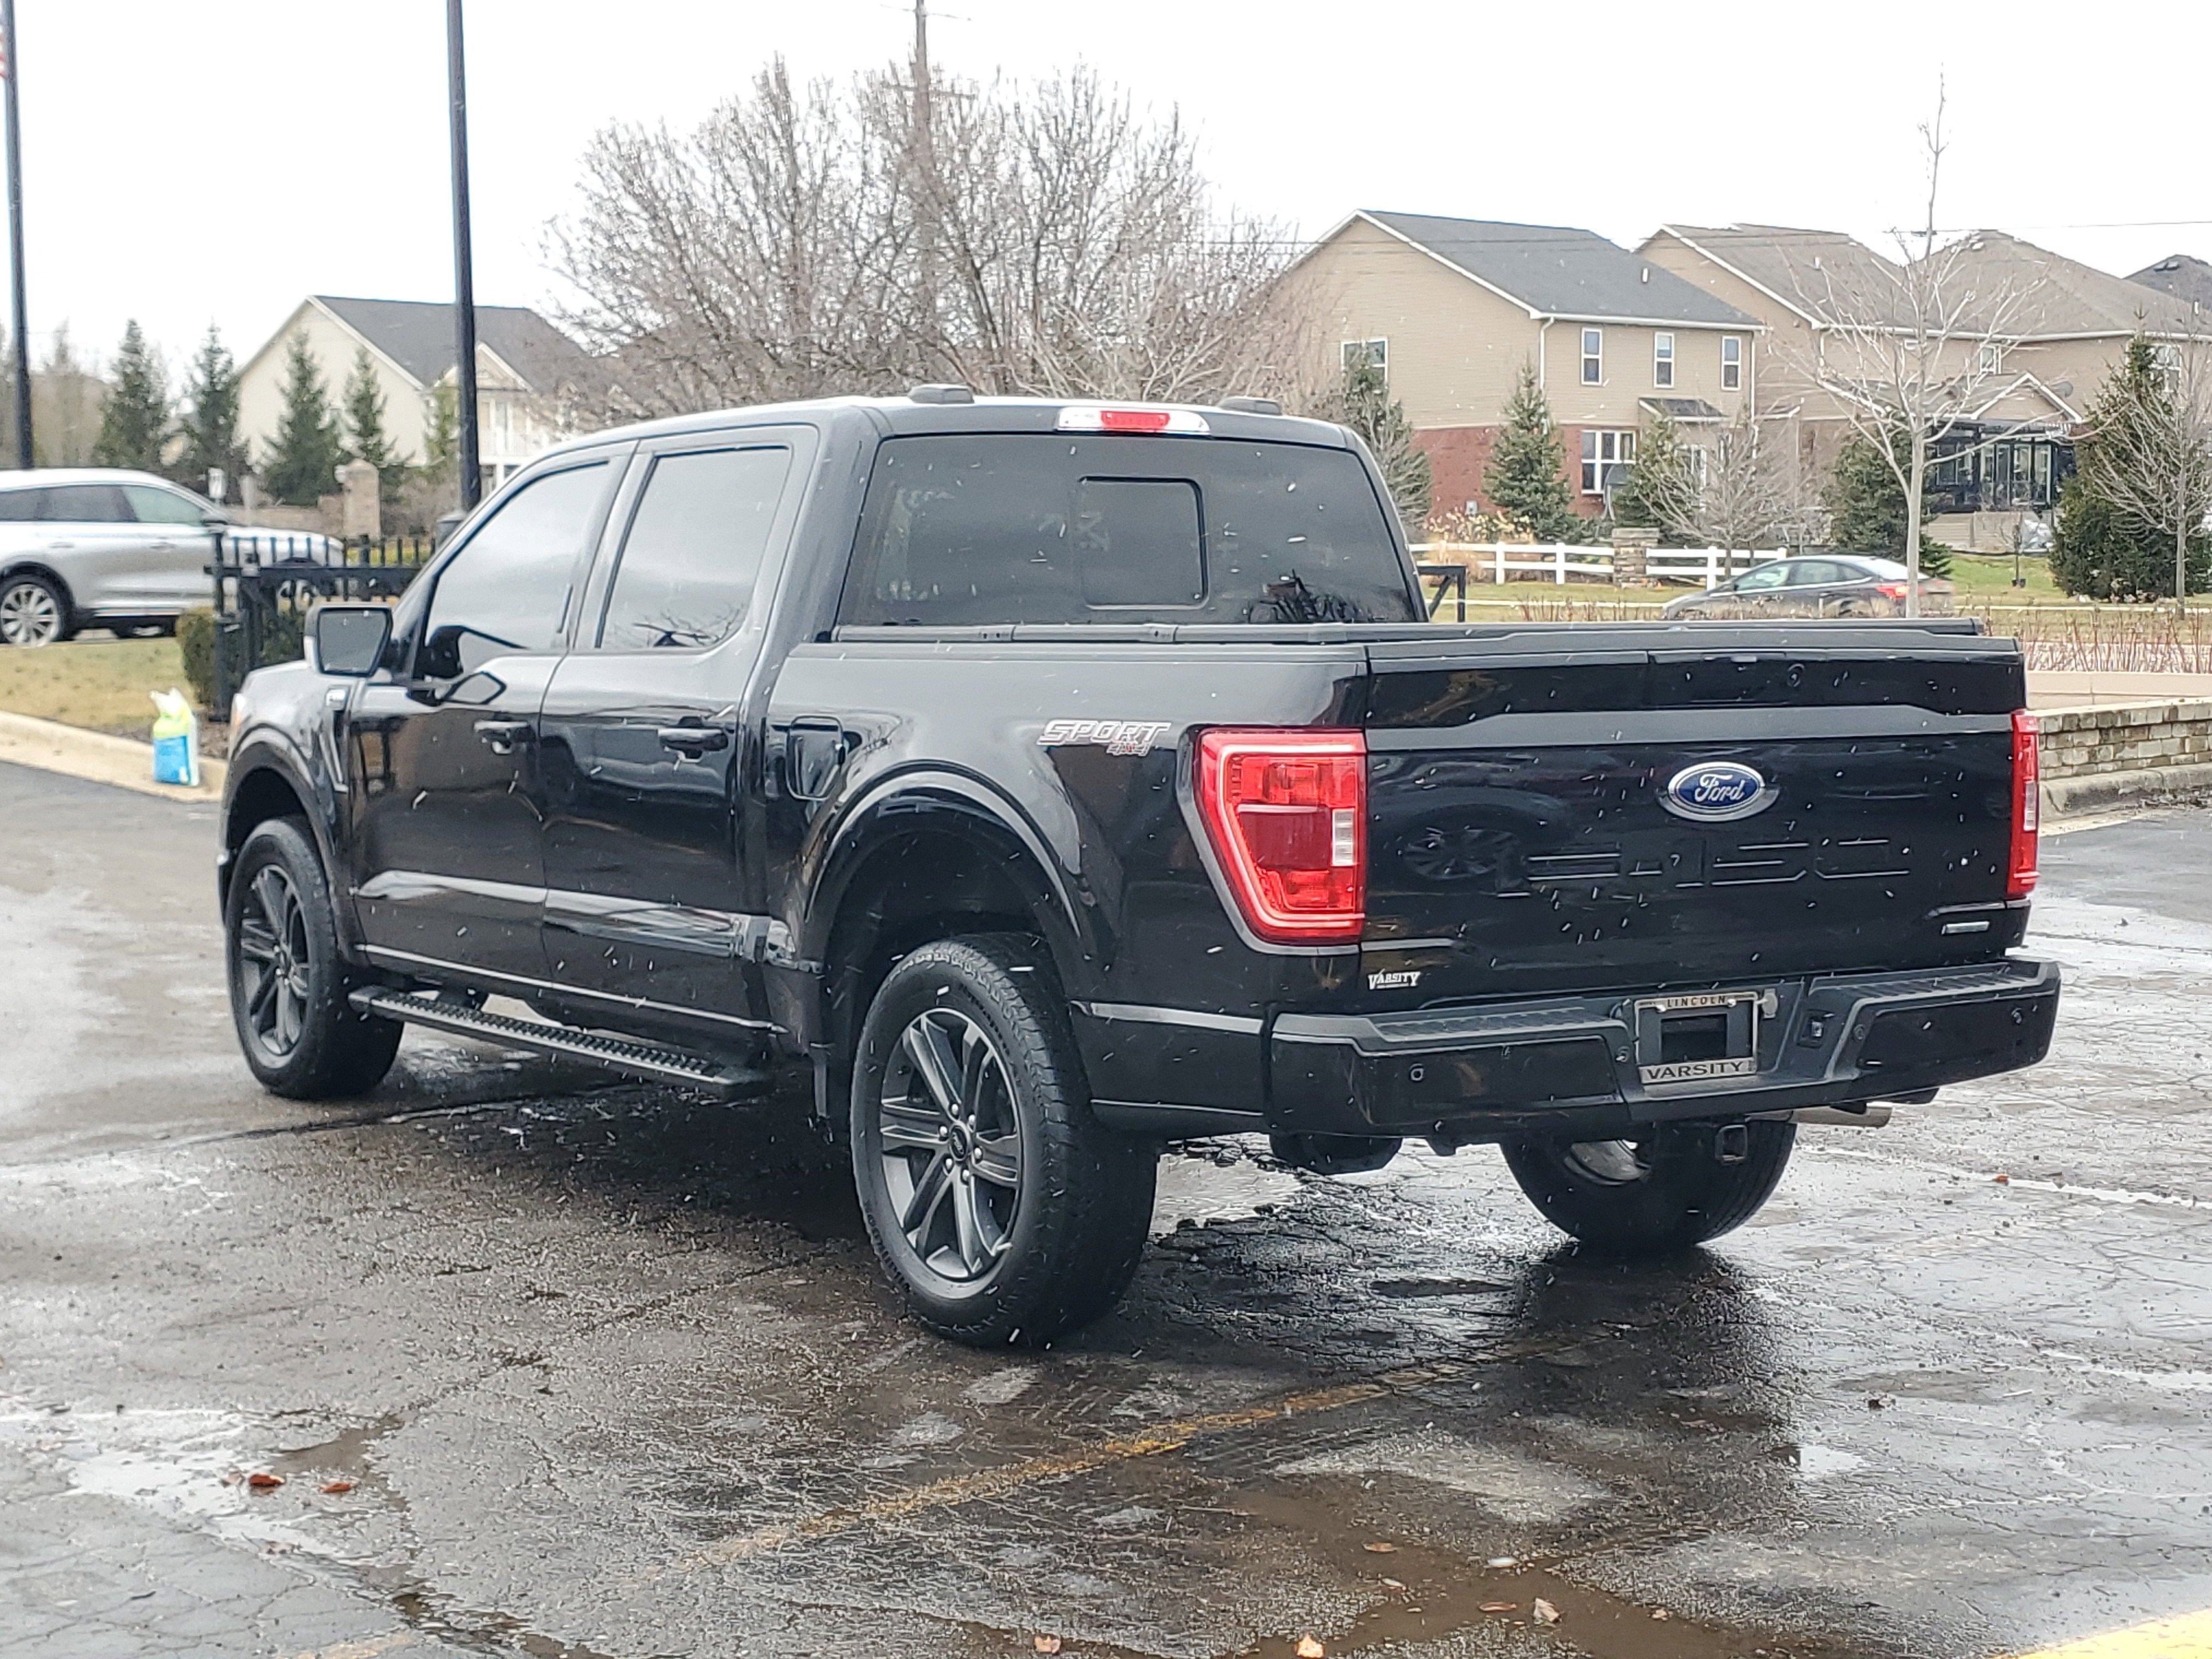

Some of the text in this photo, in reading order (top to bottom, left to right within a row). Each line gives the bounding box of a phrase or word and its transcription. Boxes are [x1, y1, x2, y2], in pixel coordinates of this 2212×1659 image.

[1037, 719, 1172, 745] SPORT
[1694, 774, 1746, 802] Ford
[1368, 971, 1421, 990] VARSITY
[1667, 995, 1726, 1008] LINCOLN
[1647, 1061, 1743, 1080] VARSITY
